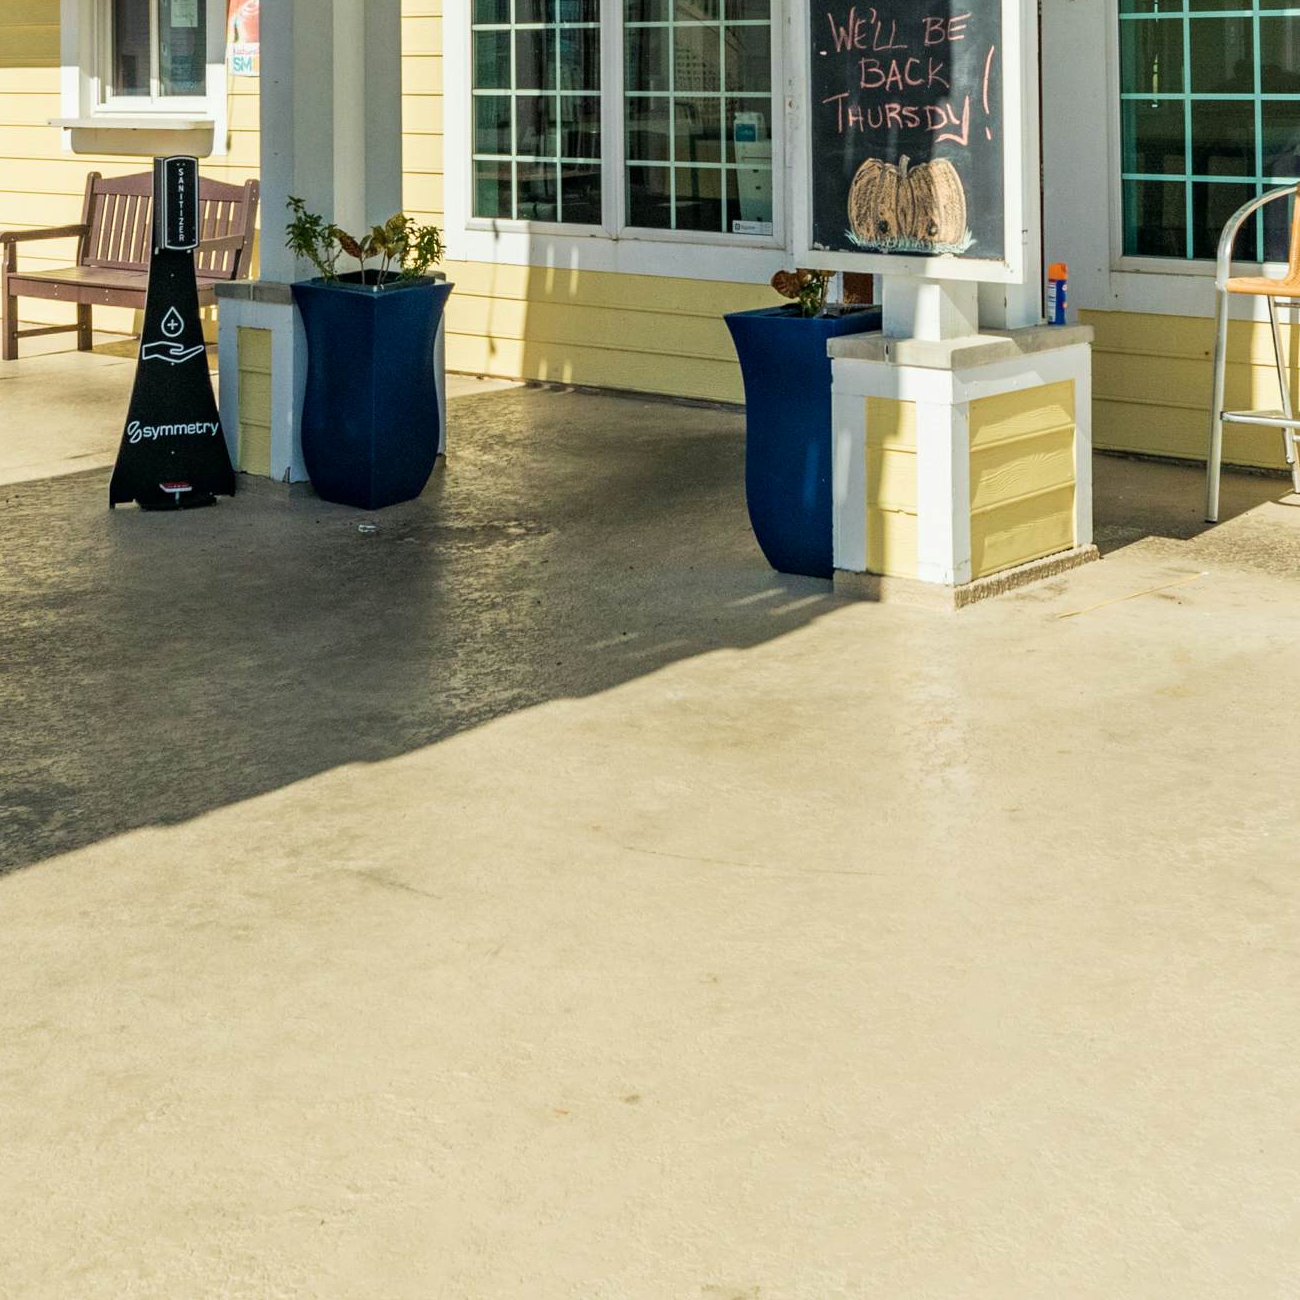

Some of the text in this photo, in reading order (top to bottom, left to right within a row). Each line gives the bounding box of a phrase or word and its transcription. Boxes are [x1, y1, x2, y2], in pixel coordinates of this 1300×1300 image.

[828, 6, 972, 52] WE'LL BE
[859, 57, 950, 92] BACK
[142, 421, 219, 441] symmetry
